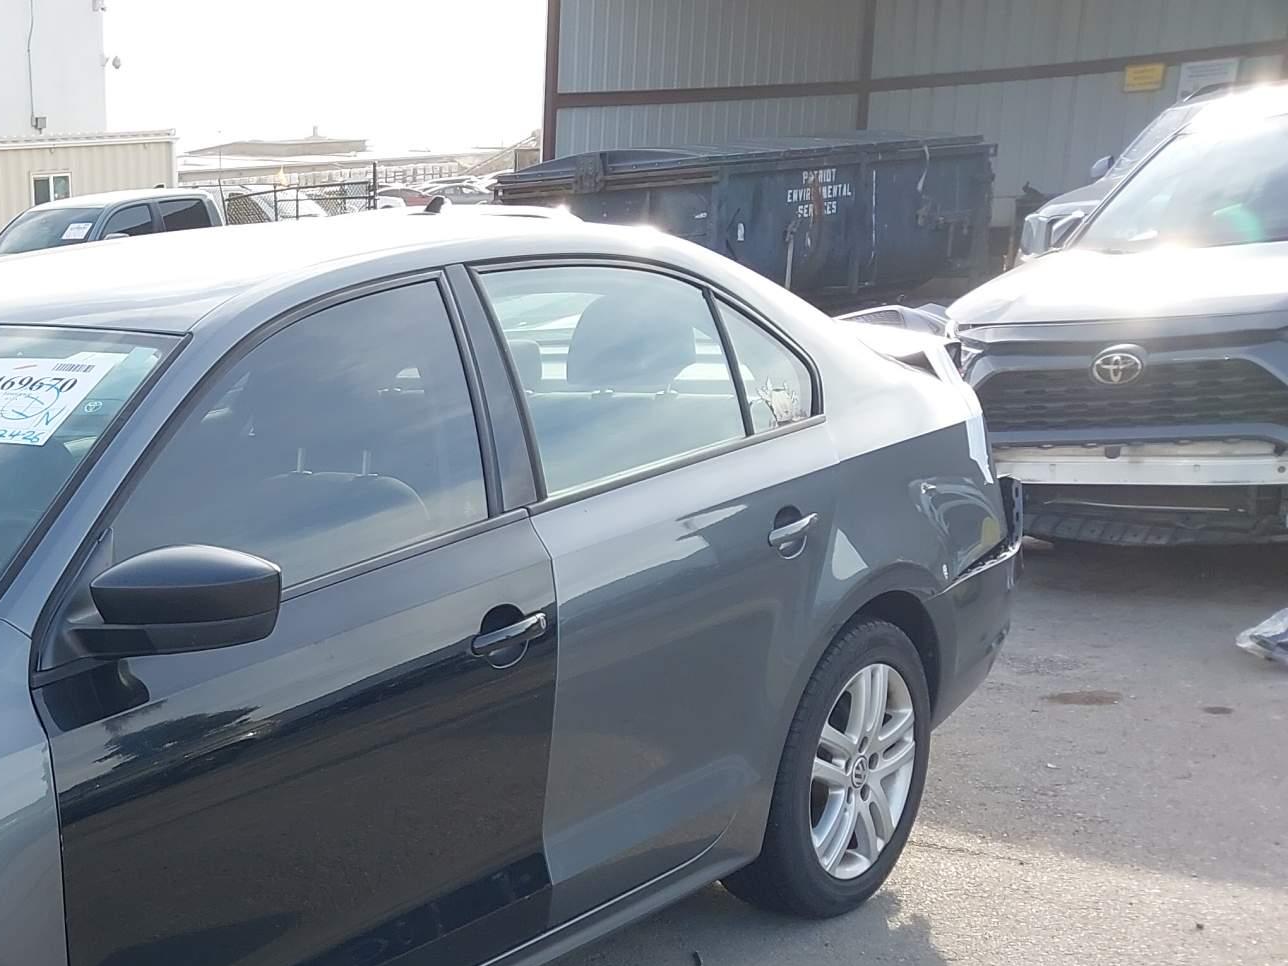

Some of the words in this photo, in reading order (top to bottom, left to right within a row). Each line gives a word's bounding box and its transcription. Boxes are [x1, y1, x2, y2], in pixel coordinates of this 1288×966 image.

[802, 168, 837, 184] PATRIOT
[787, 184, 851, 203] ENVIRMENTAL
[797, 201, 837, 218] SERCES
